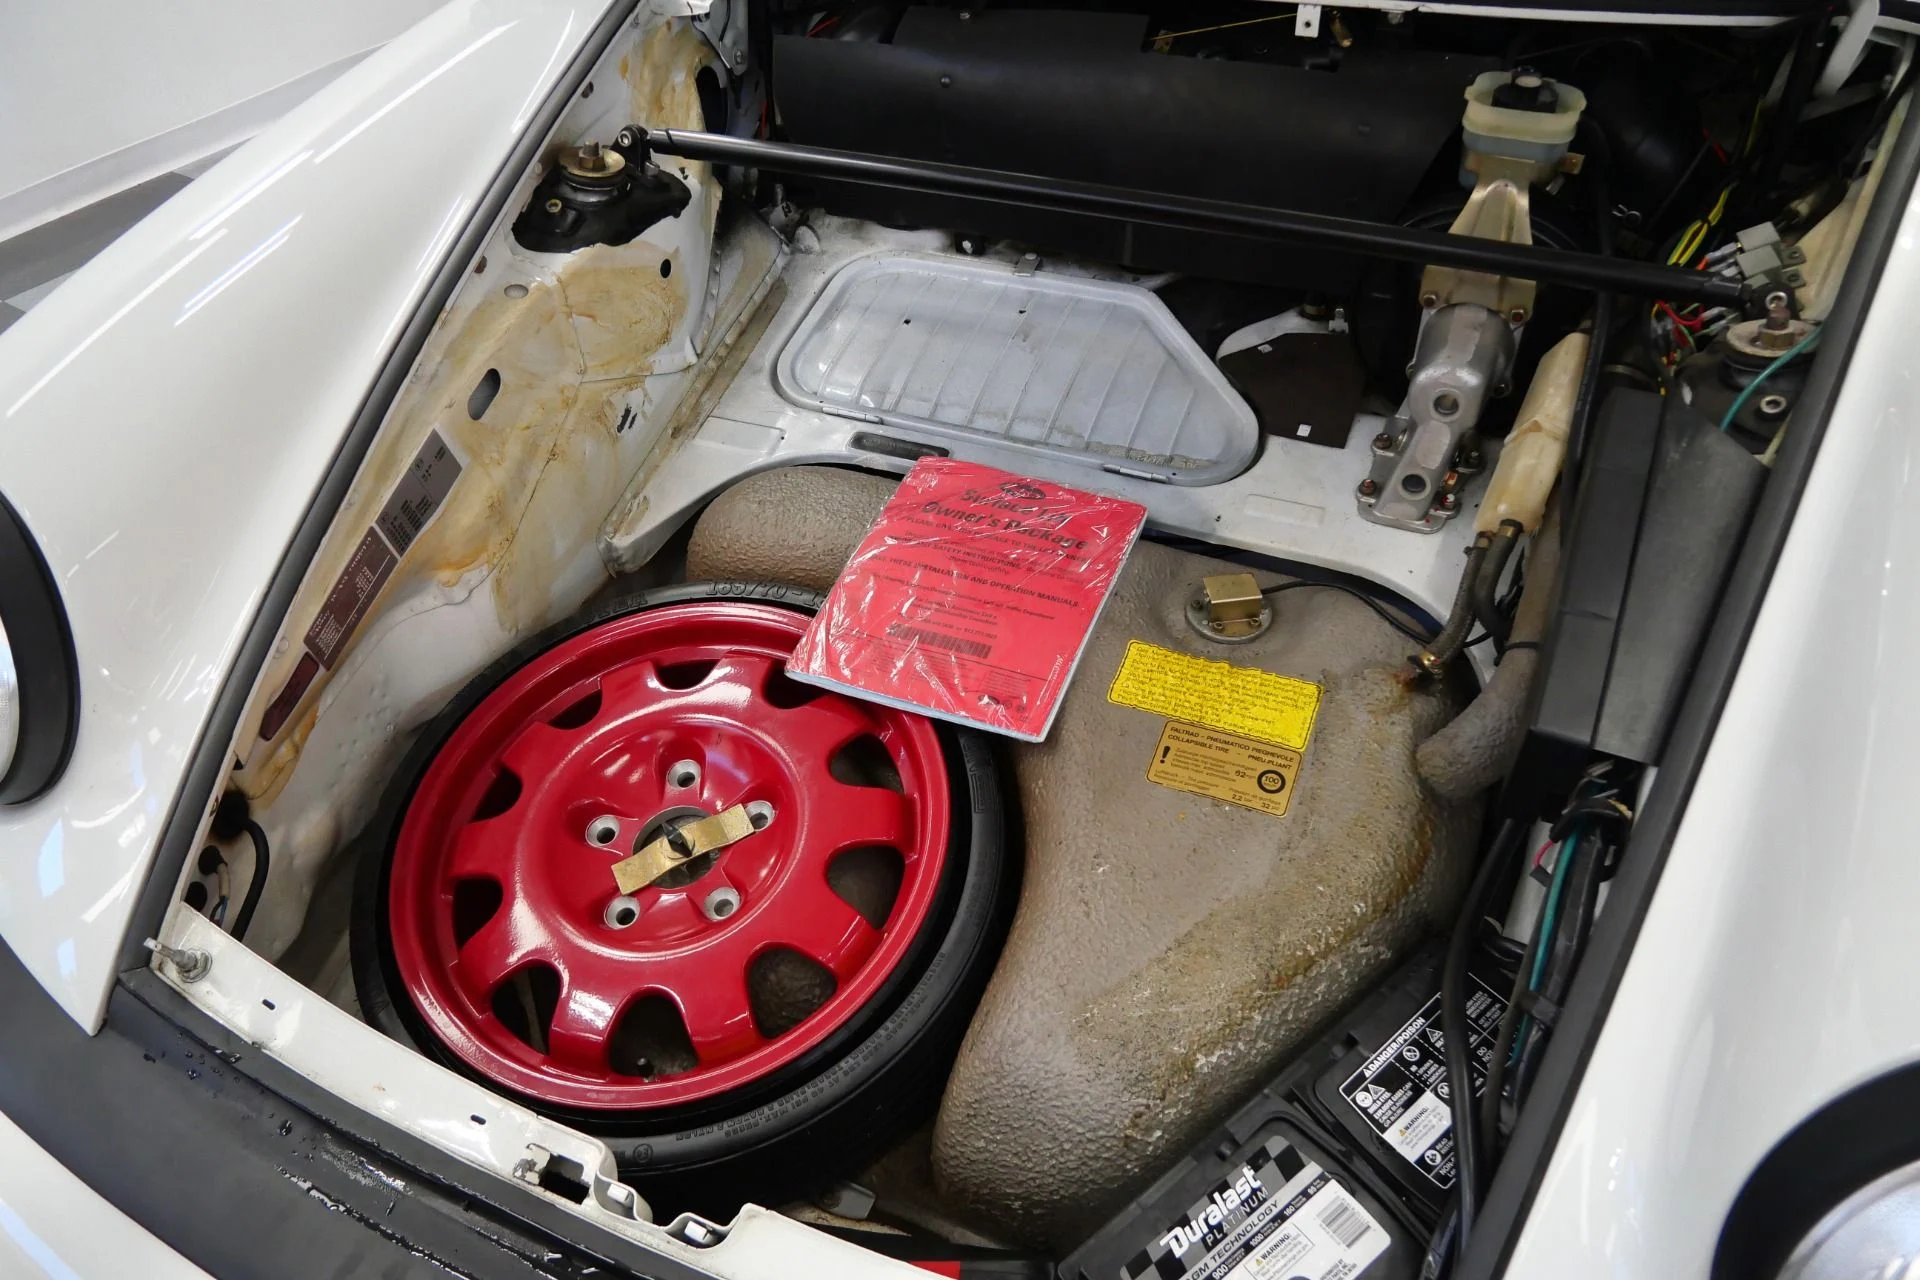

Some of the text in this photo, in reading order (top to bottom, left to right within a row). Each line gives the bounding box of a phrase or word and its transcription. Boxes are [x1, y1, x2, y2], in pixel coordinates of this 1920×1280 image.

[922, 500, 1000, 529] Owner's
[1003, 519, 1089, 552] Package
[971, 576, 988, 585] AND
[990, 581, 1034, 596] OPERATION
[1168, 733, 1212, 749] COLLAPSIBLE
[1215, 745, 1229, 753] TIRE
[1170, 726, 1198, 737] FALTRAD
[1207, 736, 1249, 750] PNEUMATICO
[1252, 747, 1293, 761] PIEGHEVOLE
[1264, 775, 1279, 784] 100
[1369, 1016, 1425, 1070] DANGER/POISON
[1476, 1045, 1487, 1056] DO
[1402, 1081, 1412, 1091] CAN
[1403, 1106, 1429, 1130] WARNING:
[1435, 1137, 1447, 1149] READ
[1159, 1165, 1261, 1257] Duralast
[1204, 1187, 1268, 1245] PLATINUM
[1210, 1200, 1279, 1262] TECHNOLOGY
[1212, 1264, 1228, 1279] 900
[1249, 1232, 1263, 1246] 1000
[1260, 1232, 1291, 1259] WARNING:
